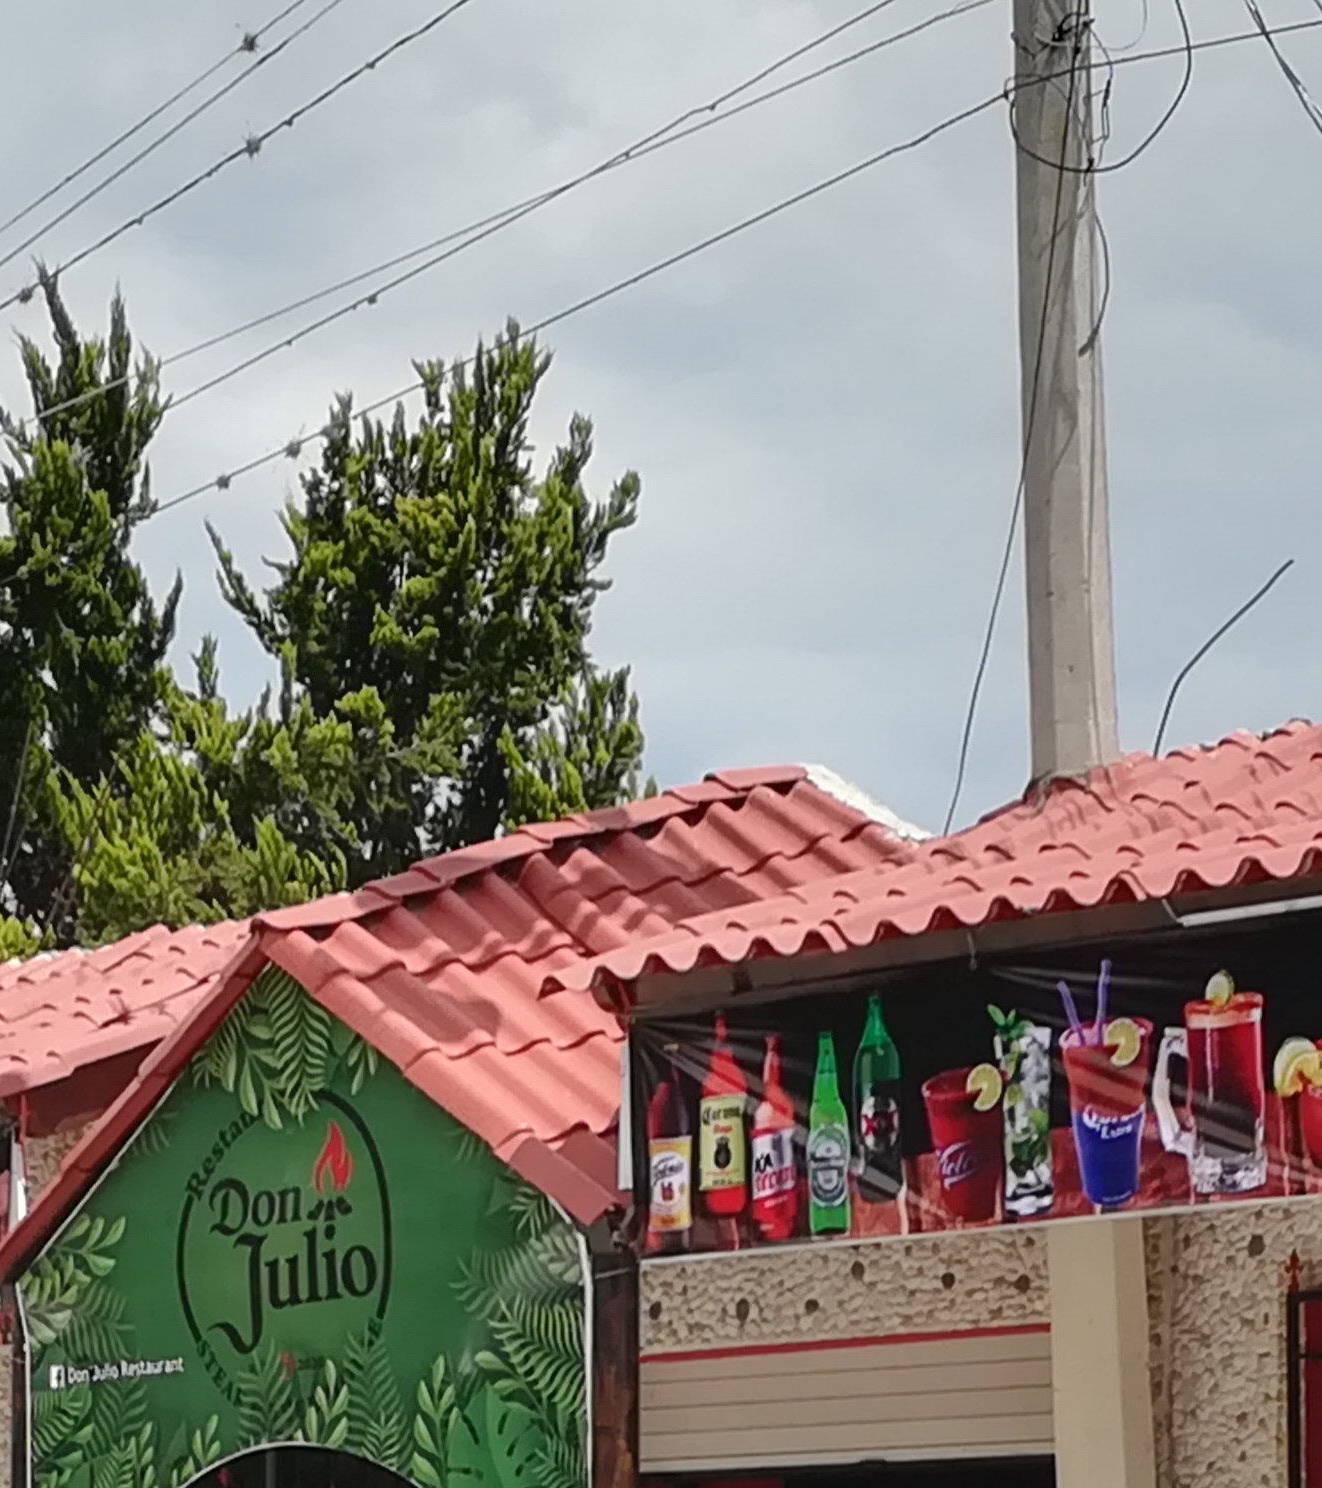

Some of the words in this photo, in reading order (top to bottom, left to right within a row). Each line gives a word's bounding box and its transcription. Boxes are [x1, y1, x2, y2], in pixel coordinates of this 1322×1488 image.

[208, 1178, 301, 1235] Don
[207, 1223, 377, 1354] Julio
[68, 1366, 89, 1385] Don
[92, 1362, 119, 1382] Julio
[120, 1357, 184, 1377] Restaurant
